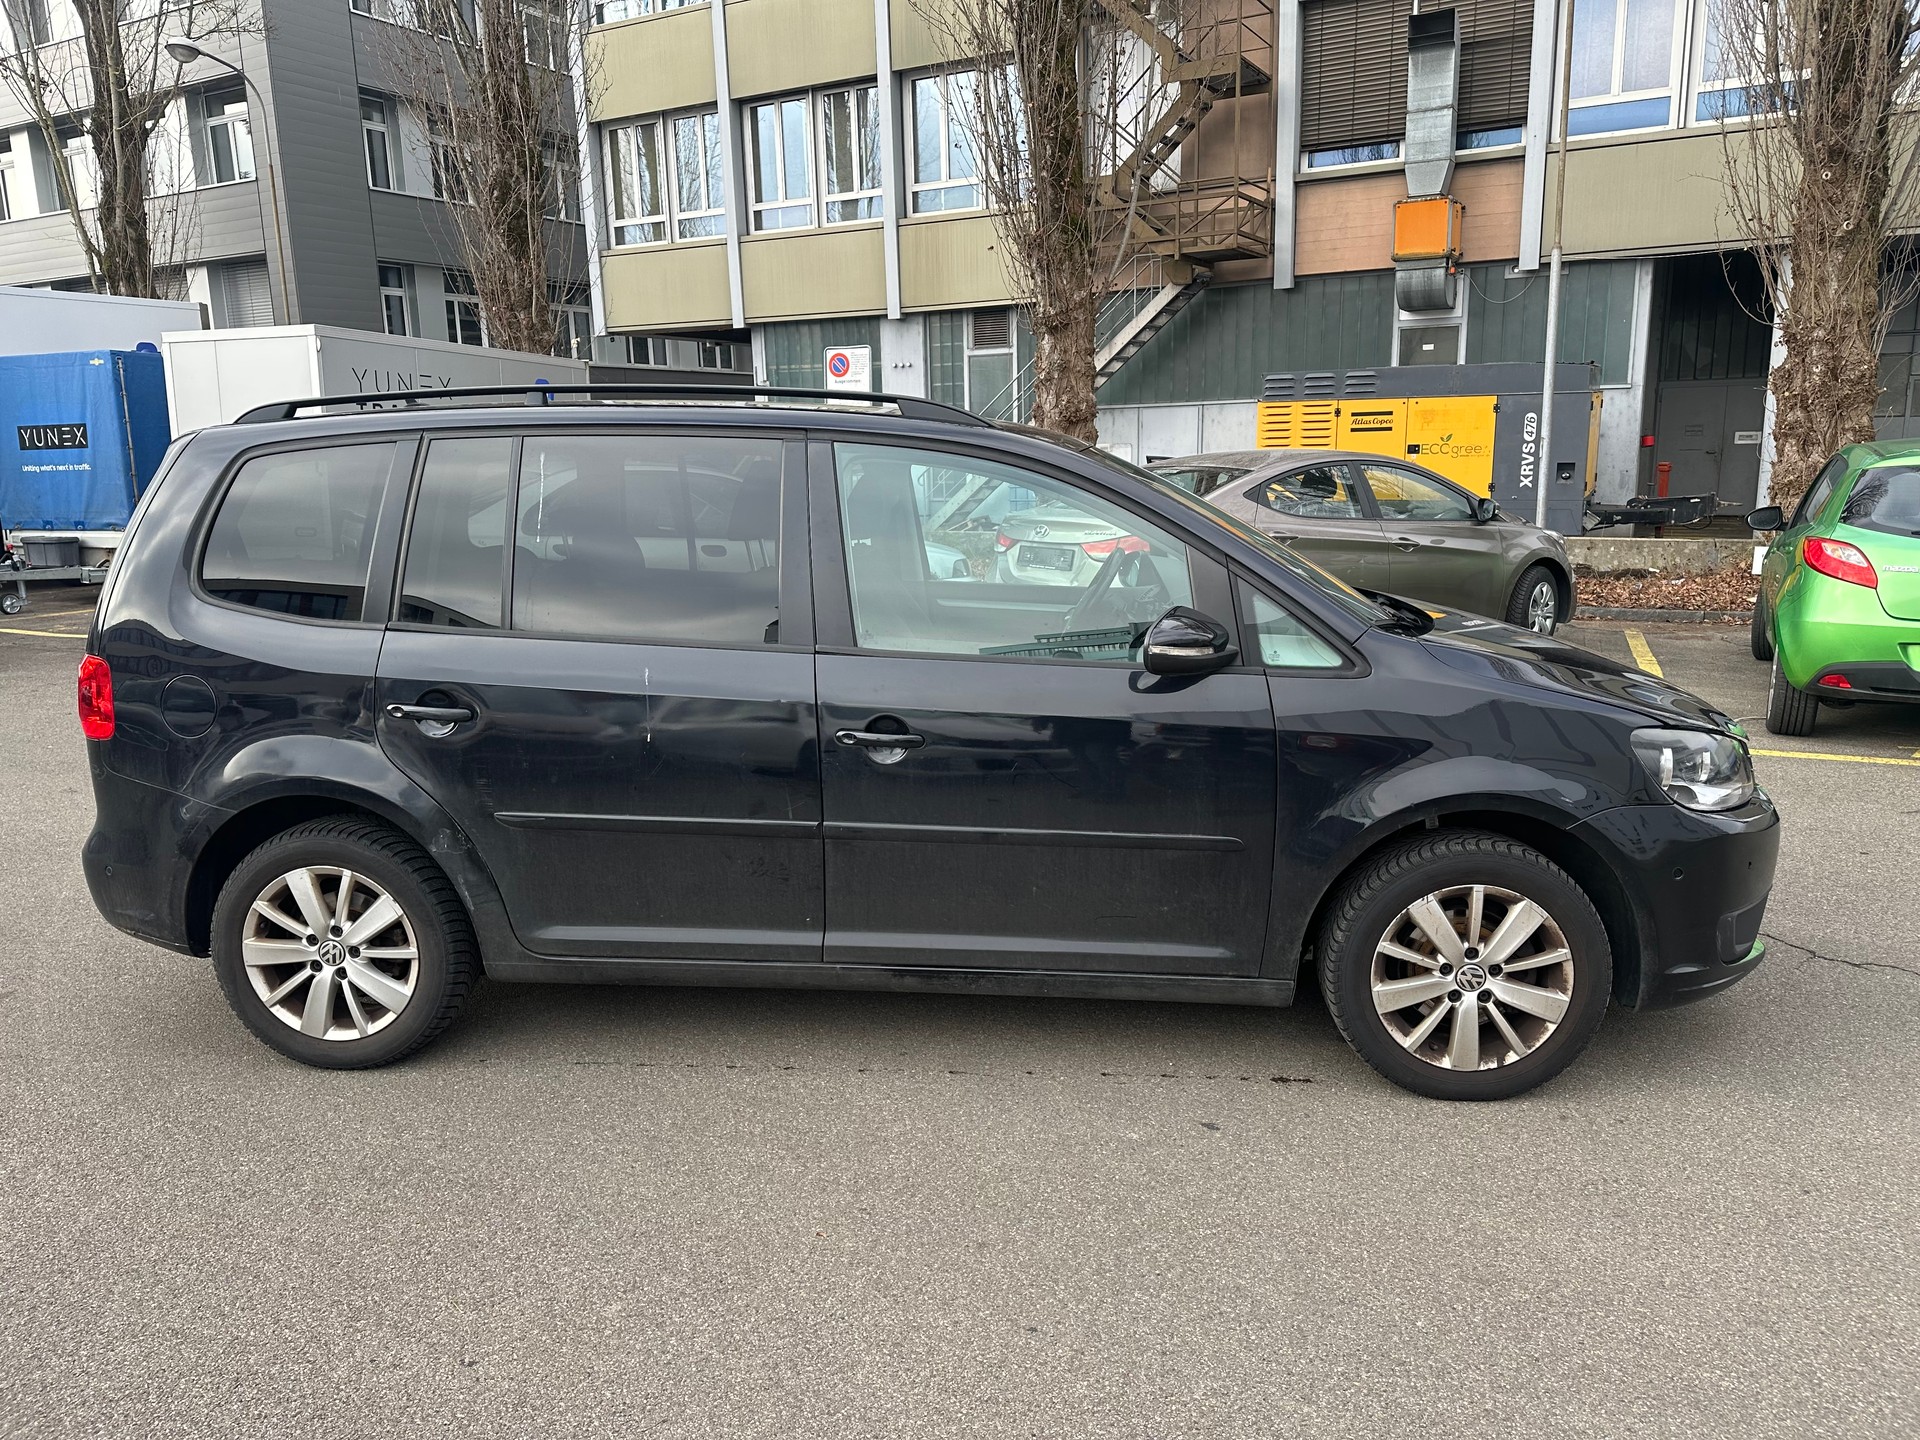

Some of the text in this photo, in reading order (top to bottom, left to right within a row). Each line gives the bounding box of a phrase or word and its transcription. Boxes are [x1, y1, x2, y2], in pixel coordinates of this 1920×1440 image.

[1372, 417, 1394, 425] Copco
[21, 426, 86, 447] YUNEX
[1520, 416, 1536, 488] XRVS 476
[21, 464, 40, 473] Uniting
[40, 464, 56, 472] what's
[57, 463, 69, 471] next
